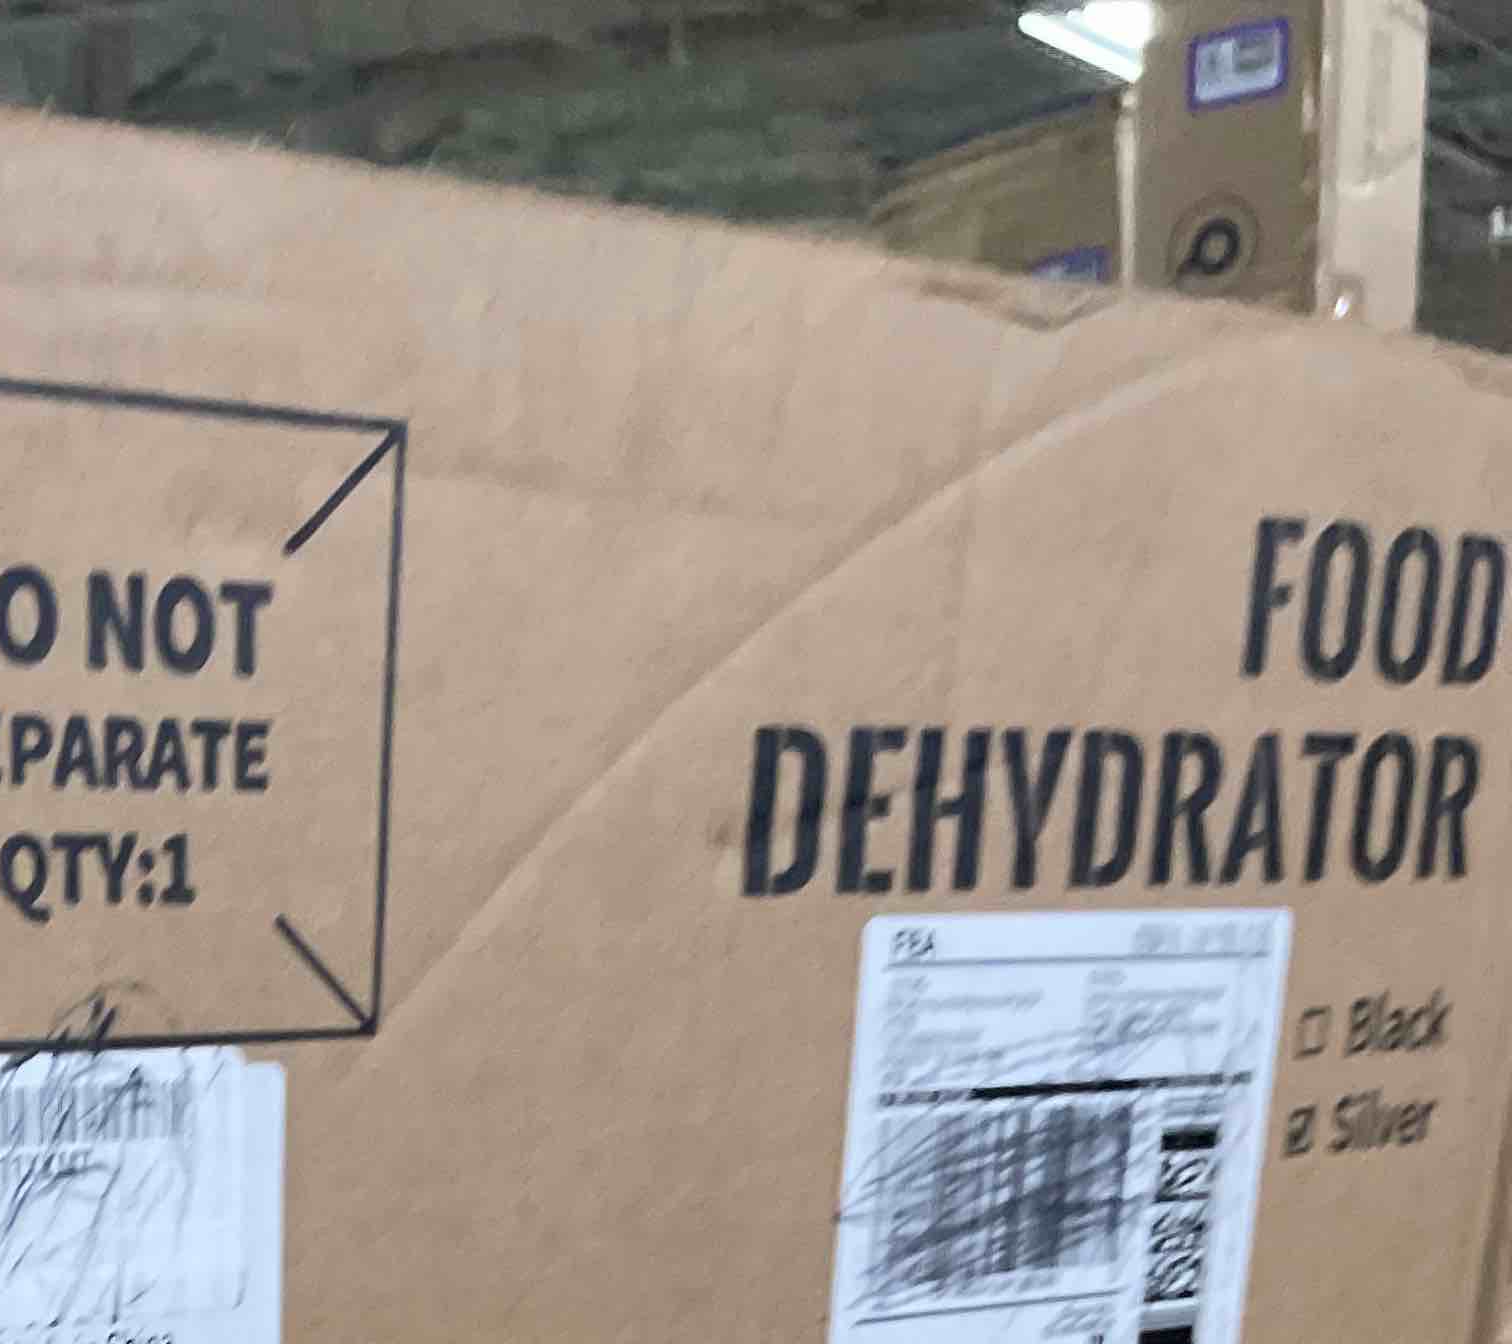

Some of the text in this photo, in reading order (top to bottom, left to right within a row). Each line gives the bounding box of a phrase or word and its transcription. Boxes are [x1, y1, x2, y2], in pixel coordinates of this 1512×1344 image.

[88, 572, 274, 677] NOT
[1241, 515, 1510, 686] FOOD
[741, 723, 1479, 897] DEHYDRATOR
[1344, 988, 1454, 1057] Black
[1326, 1088, 1439, 1154] Silver
